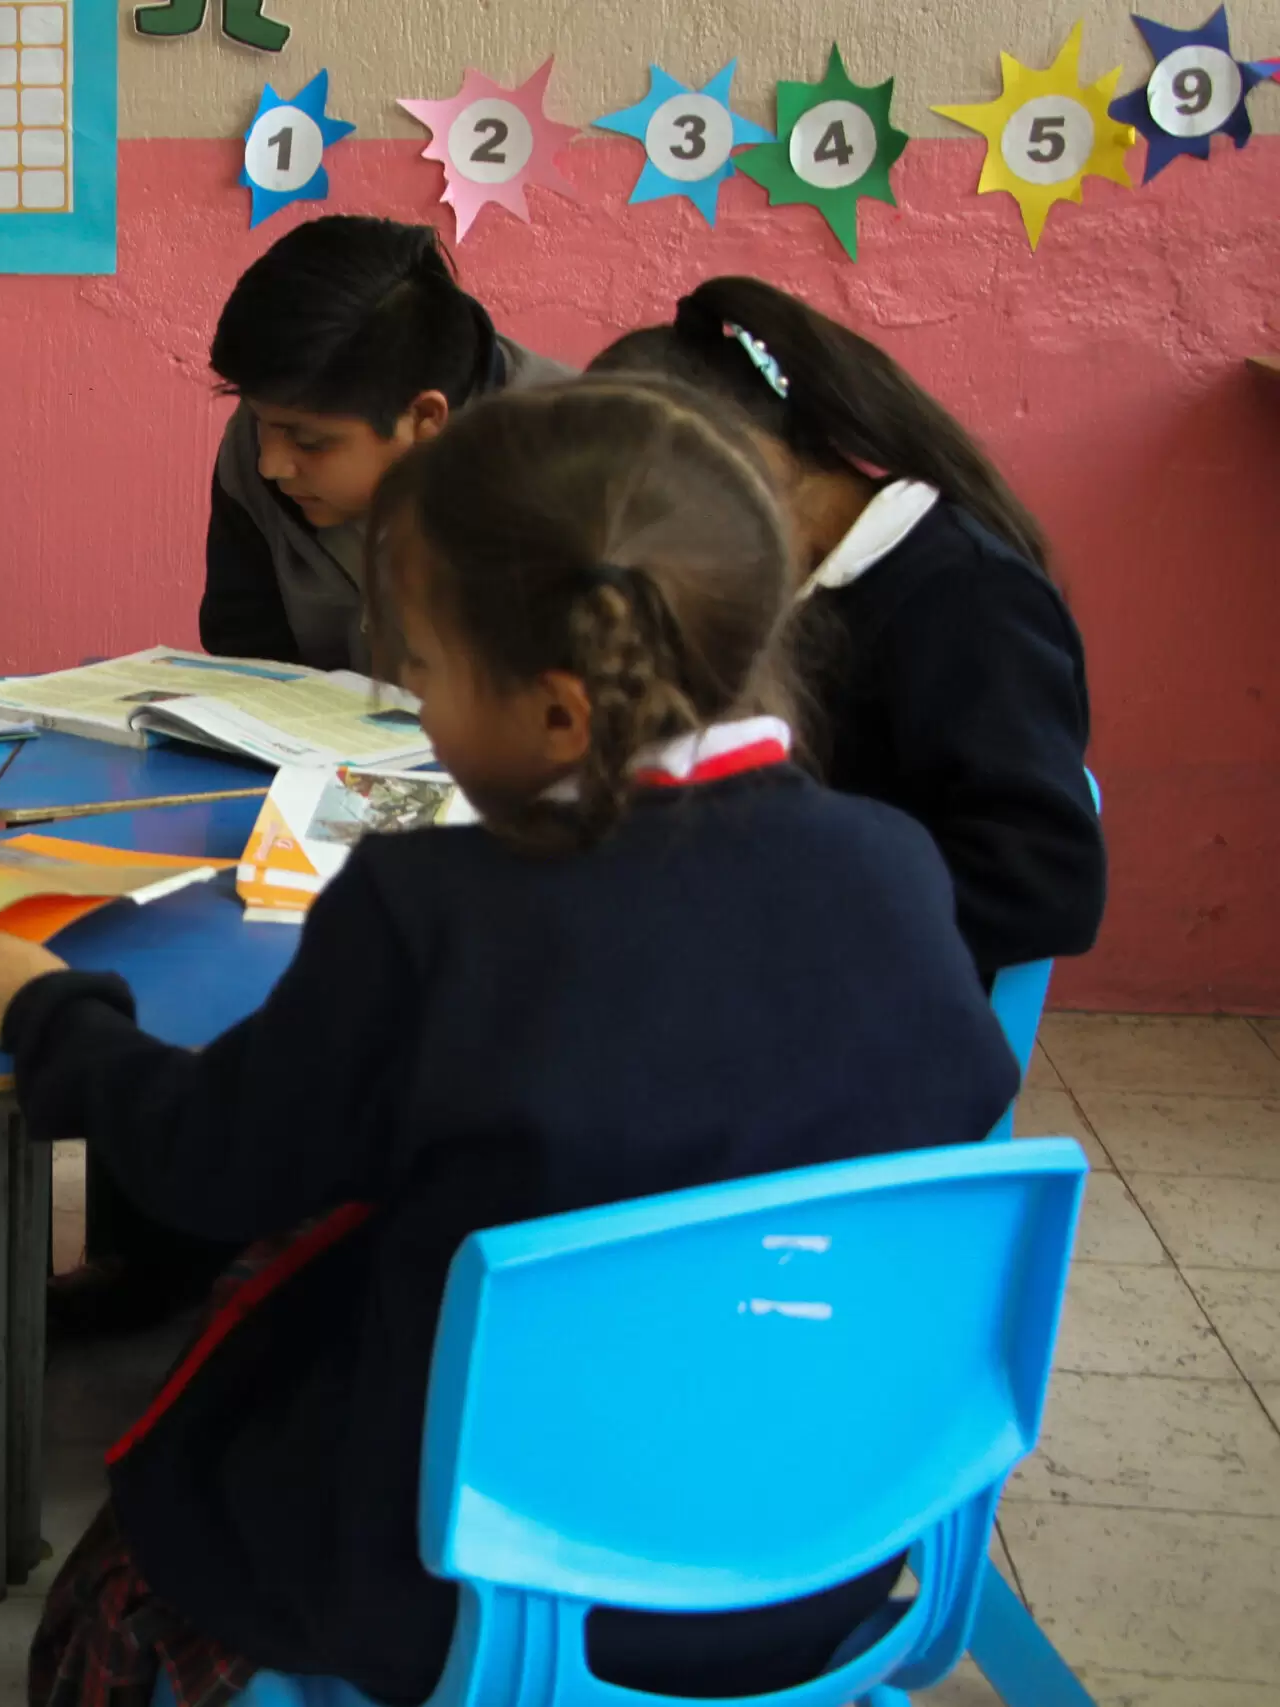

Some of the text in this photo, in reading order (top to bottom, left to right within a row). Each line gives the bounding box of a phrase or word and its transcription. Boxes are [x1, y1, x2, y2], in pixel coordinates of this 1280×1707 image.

[1173, 68, 1212, 115] 9
[268, 128, 292, 170] 1
[470, 118, 508, 163] 2
[670, 115, 706, 160] 3
[814, 120, 854, 166] 4
[1027, 116, 1065, 163] 5
